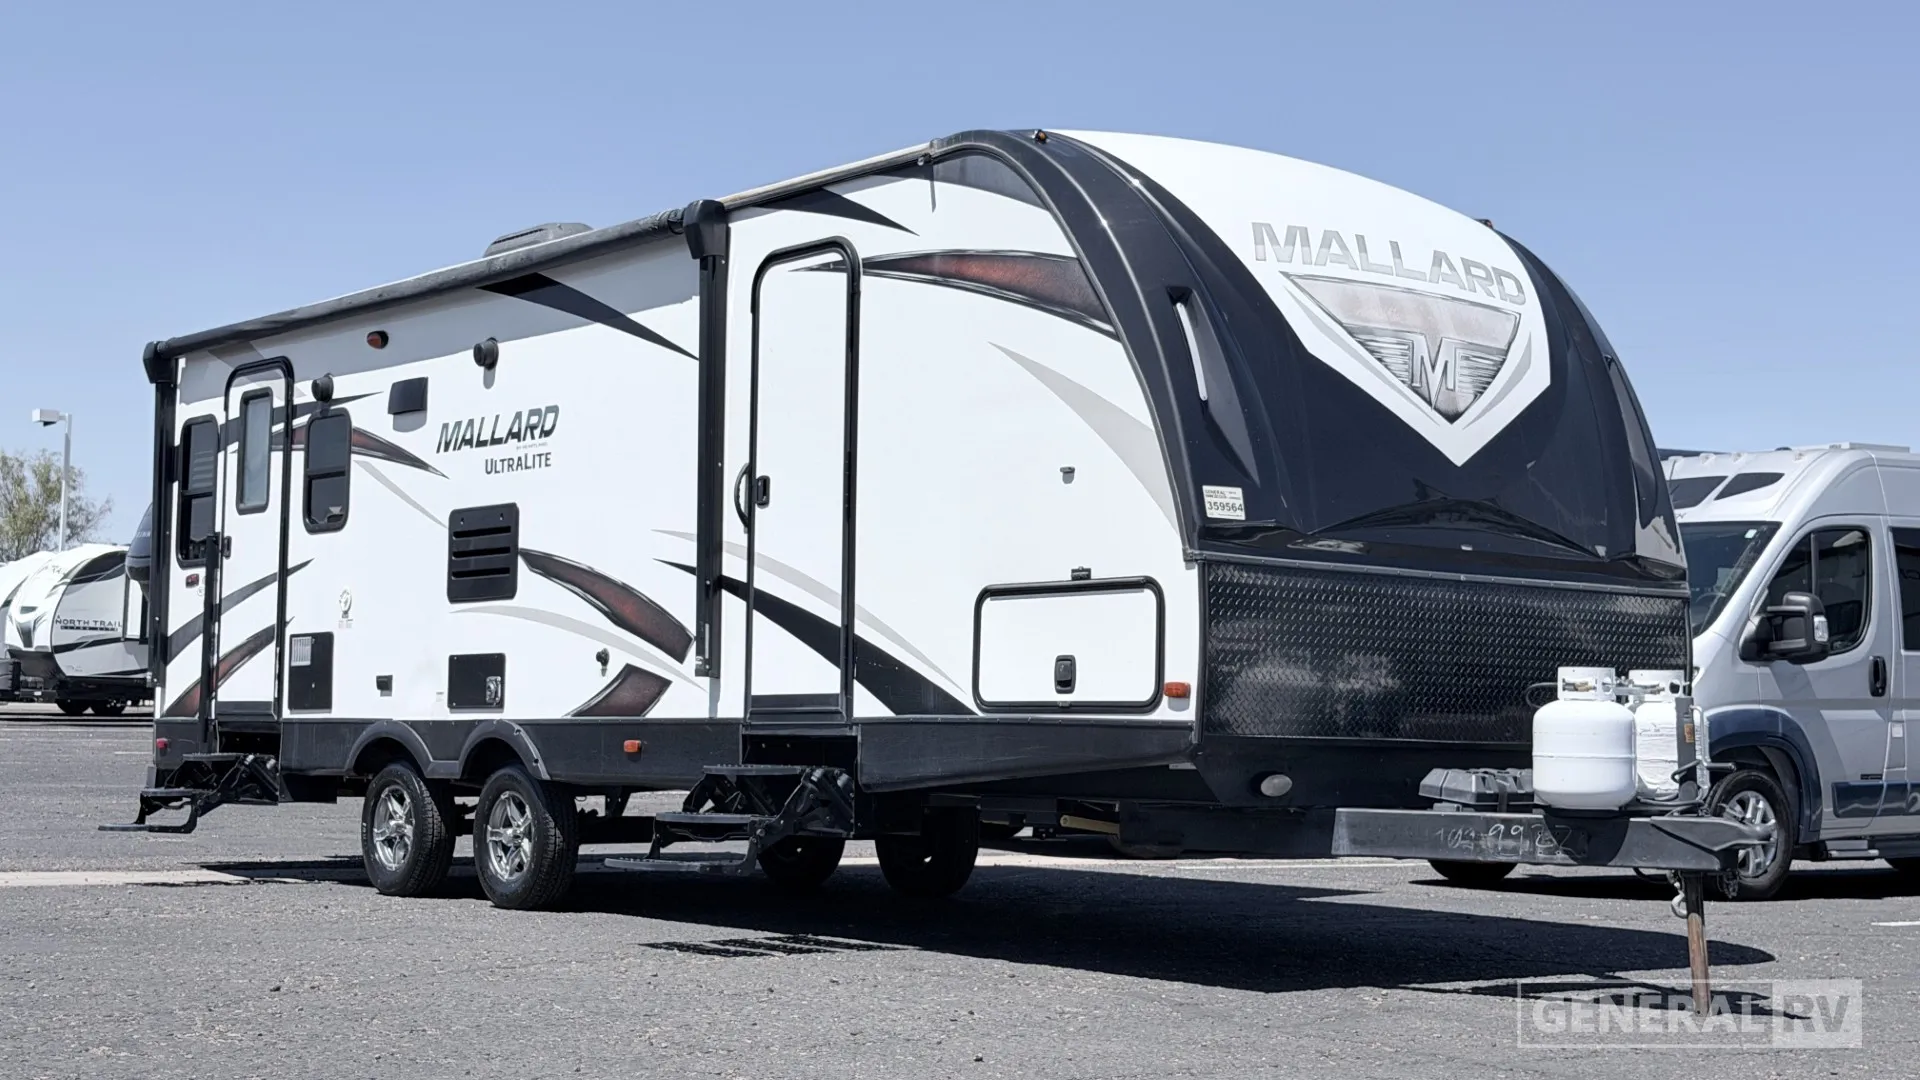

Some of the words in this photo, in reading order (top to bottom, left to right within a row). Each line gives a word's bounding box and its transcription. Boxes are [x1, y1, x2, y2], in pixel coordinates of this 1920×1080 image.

[1251, 222, 1526, 306] MALLARD
[436, 405, 560, 454] MALLARD
[485, 452, 552, 475] ULTRALITE
[1208, 501, 1243, 512] 359564
[55, 618, 90, 626] NORTH
